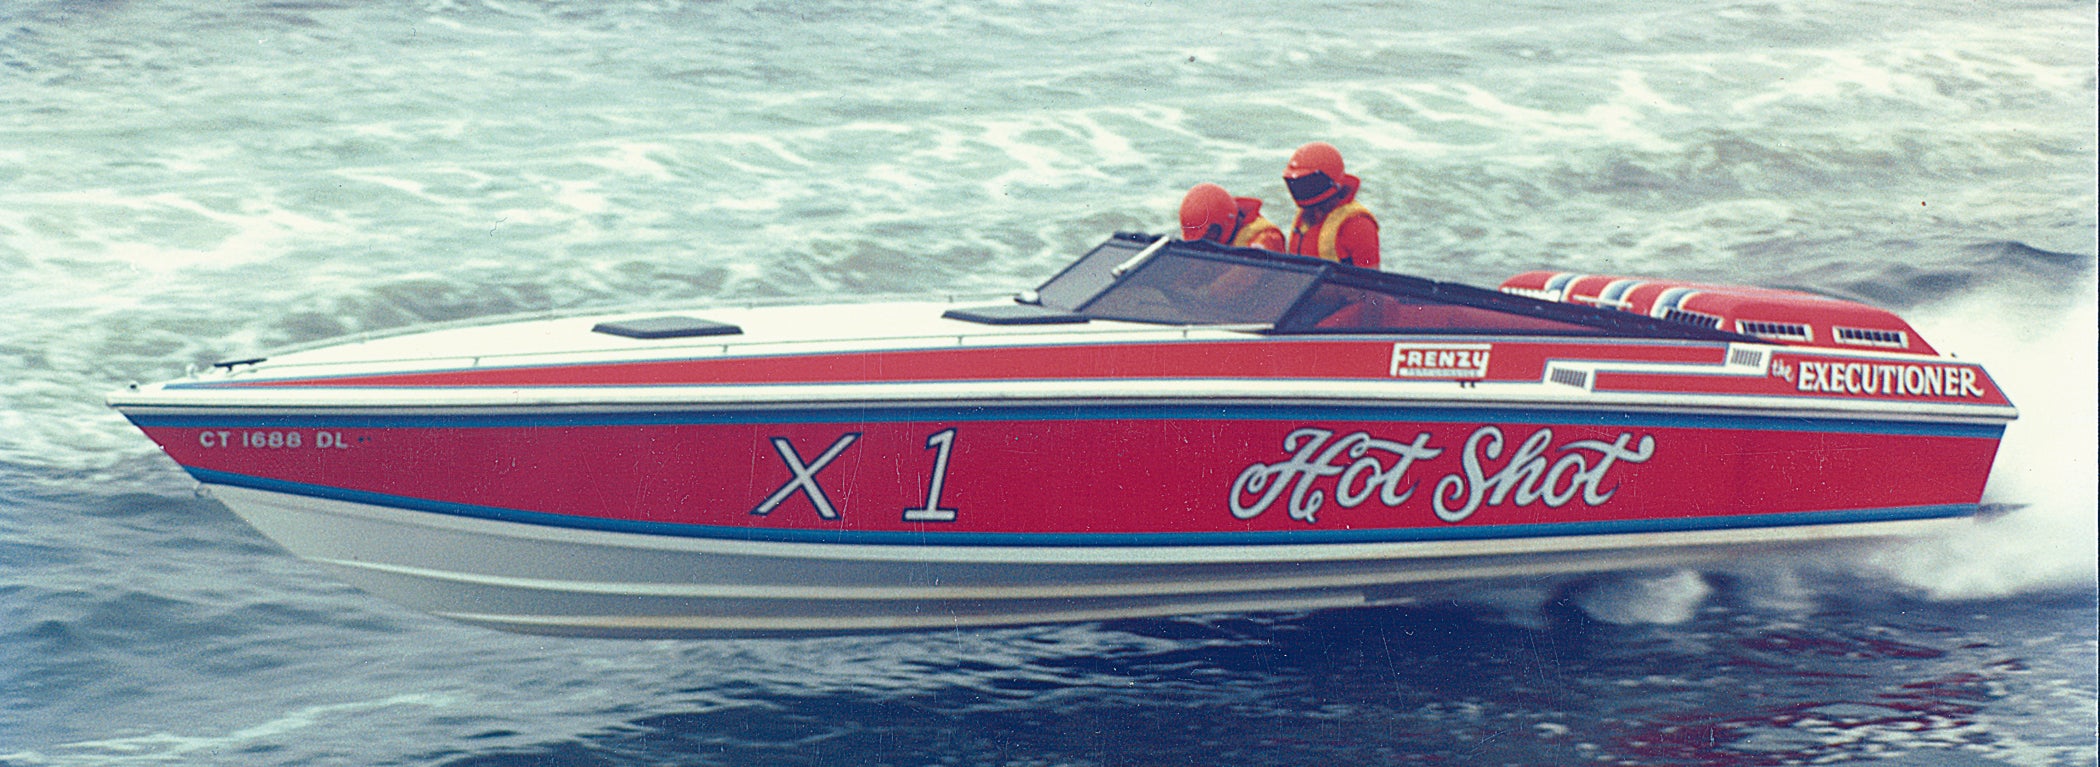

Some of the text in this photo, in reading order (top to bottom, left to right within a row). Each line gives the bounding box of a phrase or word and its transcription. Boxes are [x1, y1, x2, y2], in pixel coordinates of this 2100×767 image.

[1389, 342, 1493, 378] FRENZY
[1771, 359, 1985, 397] the EXECUTIONER
[199, 431, 348, 448] CT 1688 DL
[750, 427, 959, 522] X 1
[1228, 425, 1655, 524] Hot Shot
